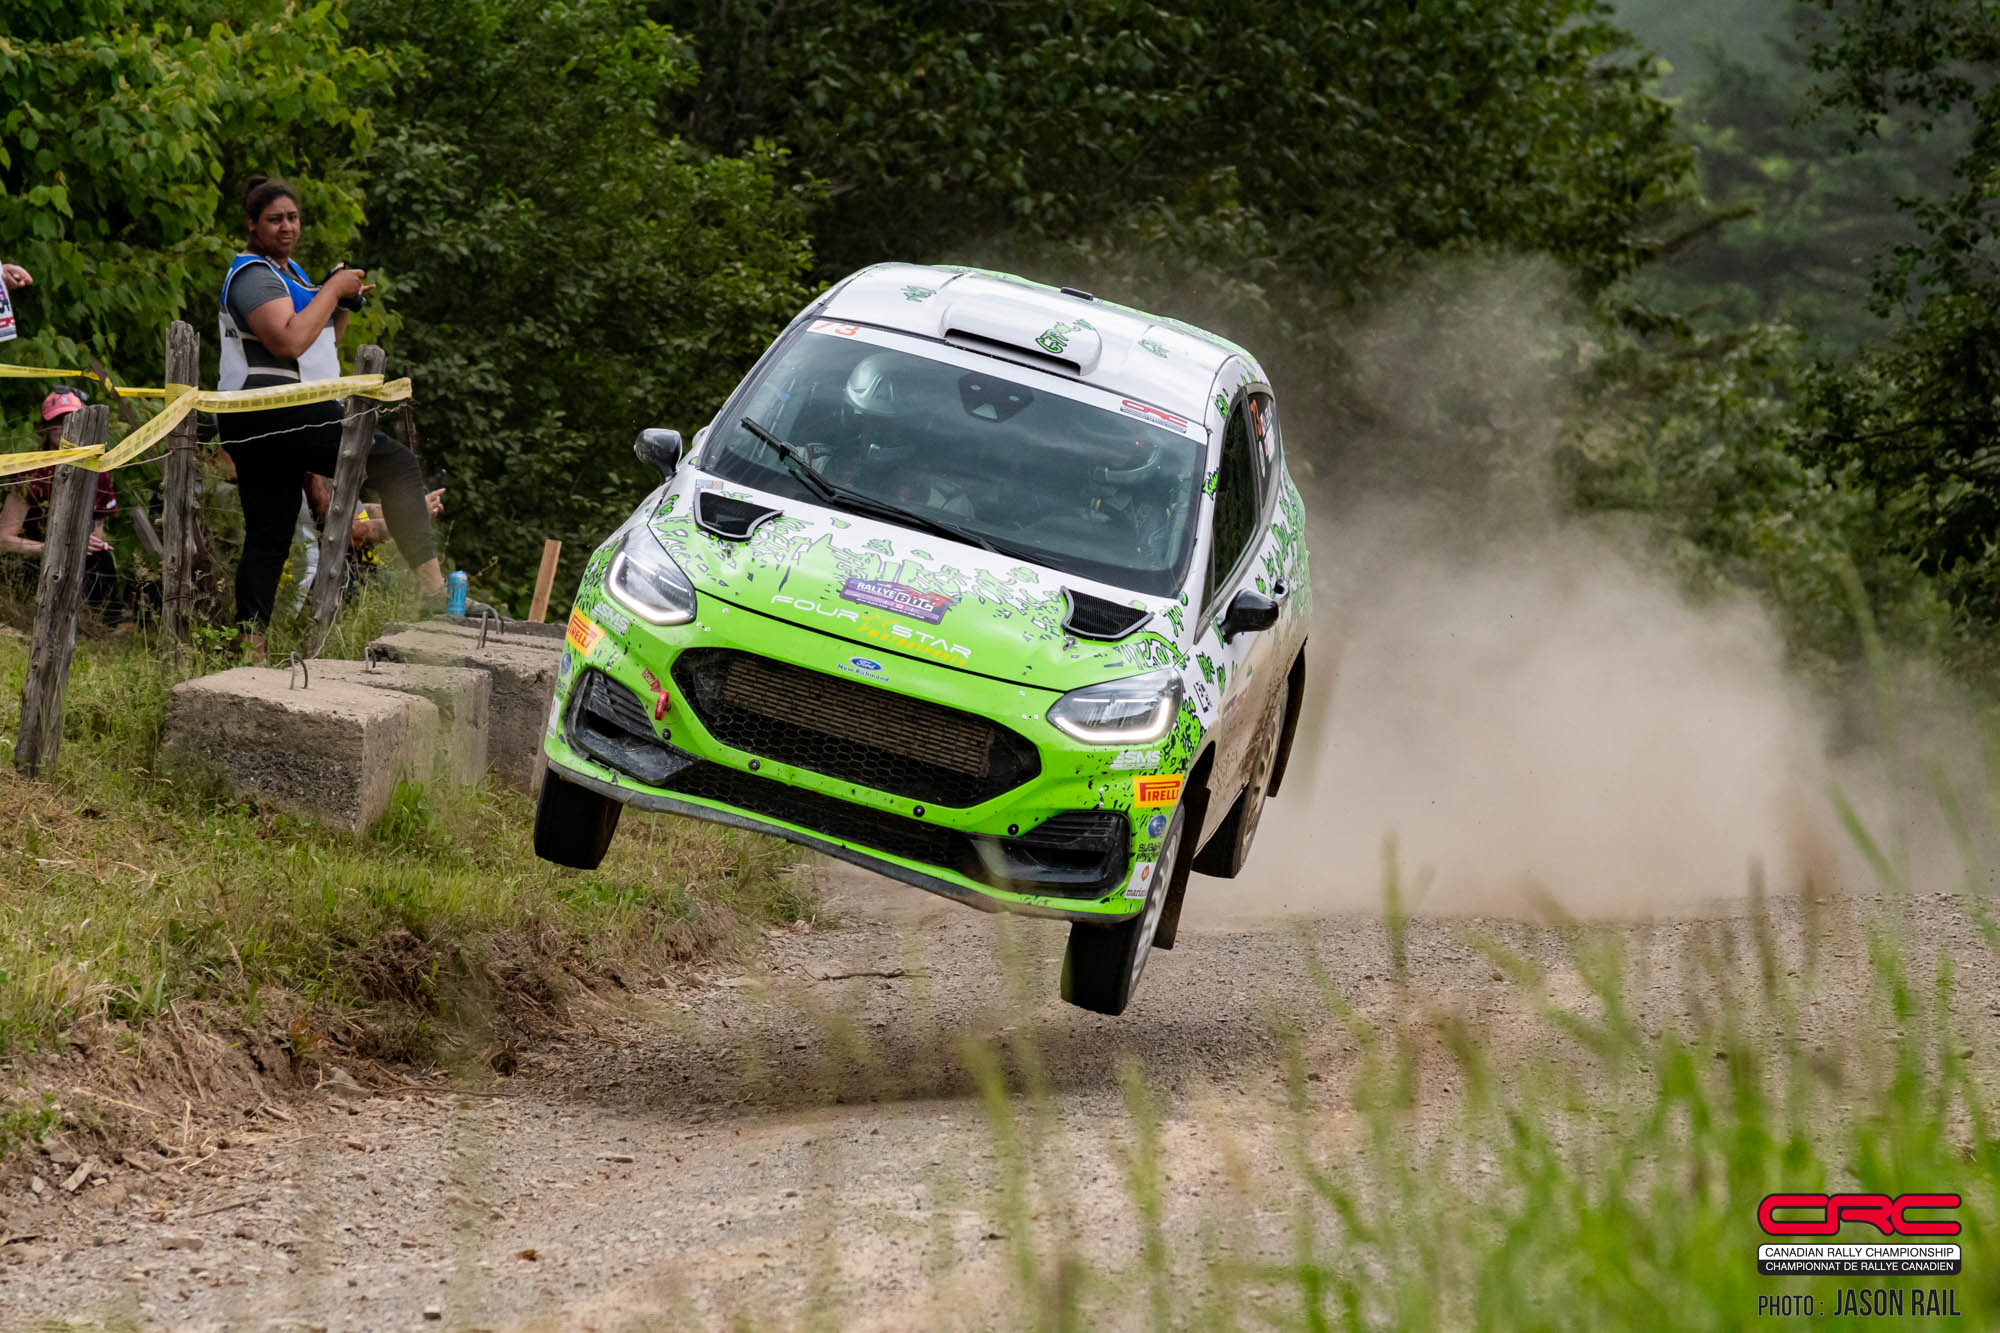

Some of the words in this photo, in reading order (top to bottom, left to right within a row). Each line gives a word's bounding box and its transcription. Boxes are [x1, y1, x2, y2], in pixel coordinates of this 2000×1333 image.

[1122, 399, 1188, 429] CRC
[856, 582, 897, 599] RALLYE
[770, 594, 860, 623] FOUR
[890, 623, 972, 660] STAR
[1139, 780, 1181, 802] PIRELLI
